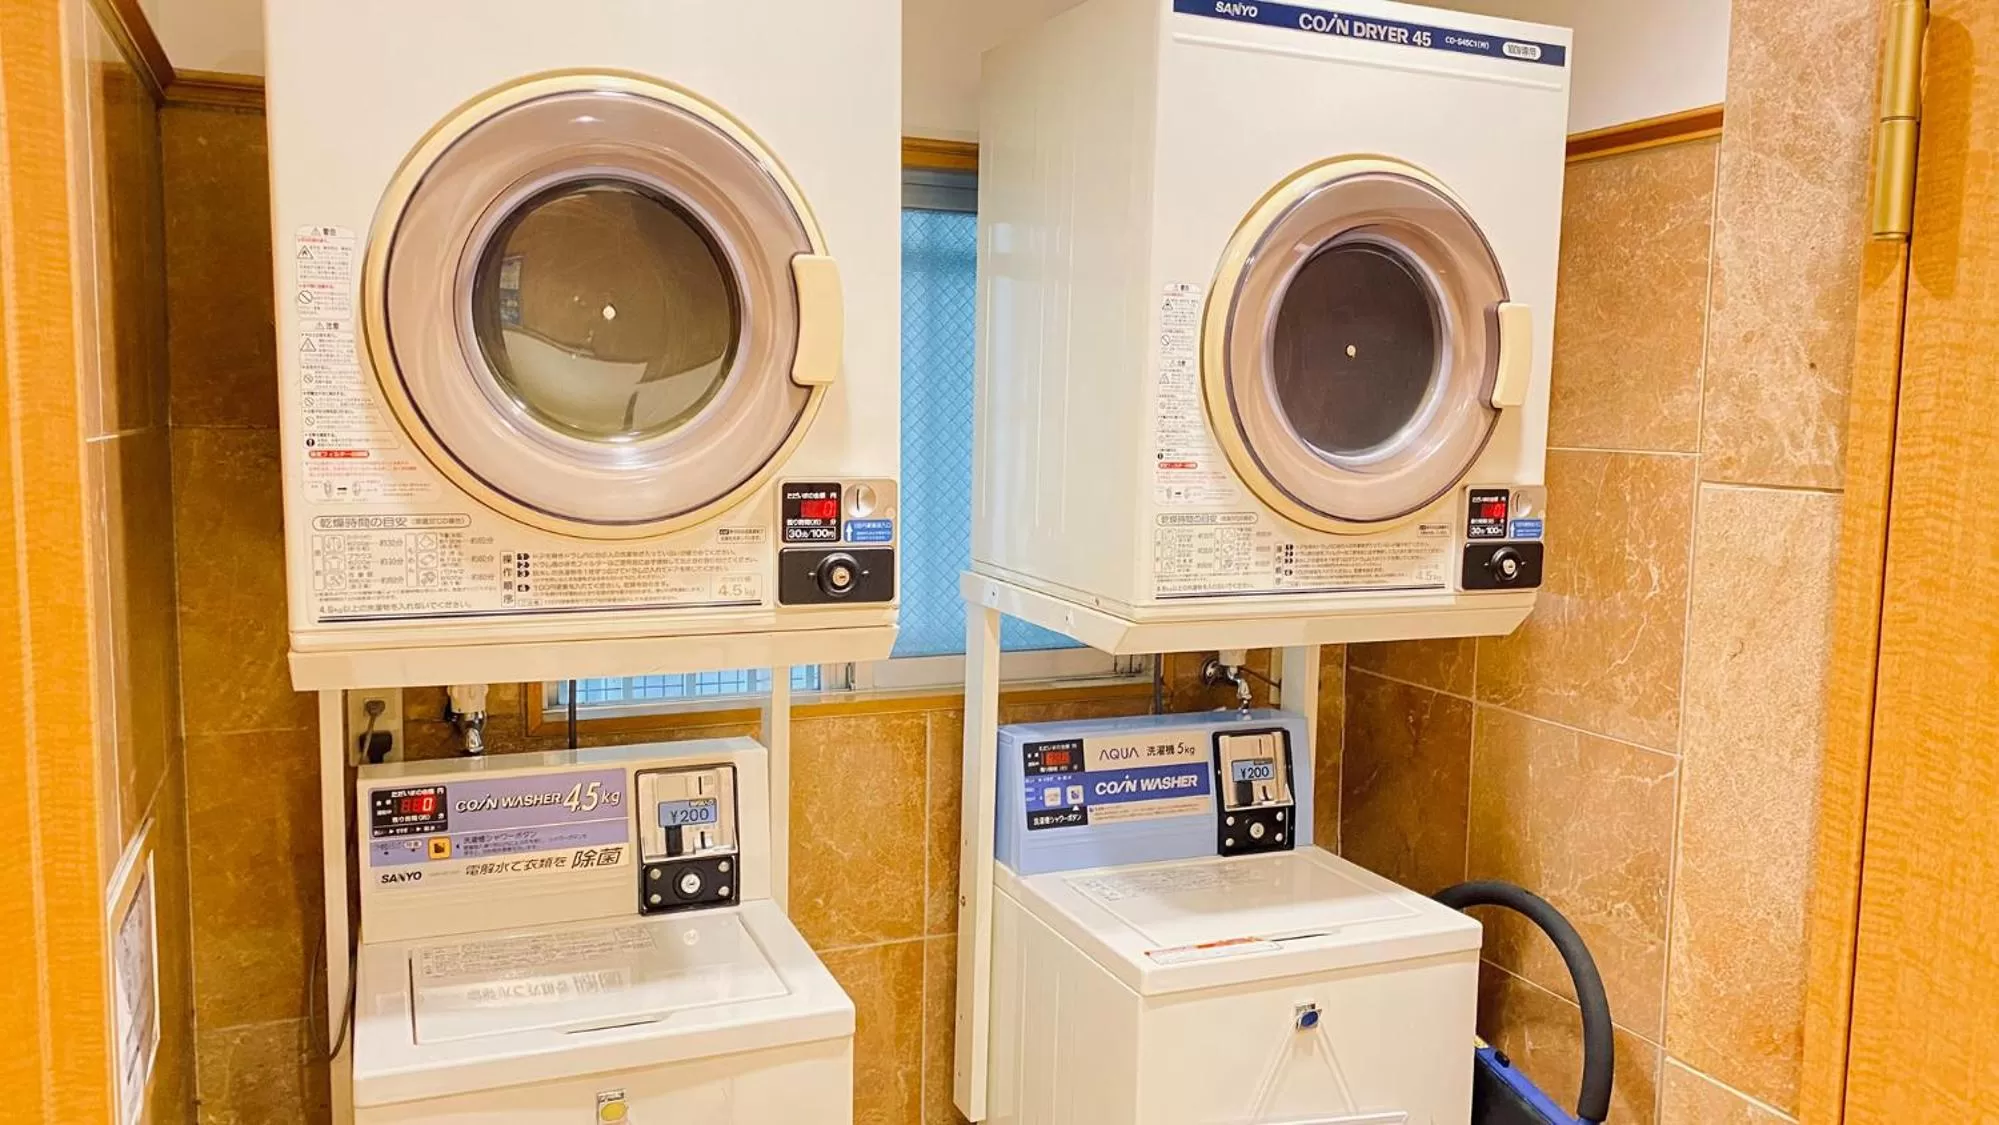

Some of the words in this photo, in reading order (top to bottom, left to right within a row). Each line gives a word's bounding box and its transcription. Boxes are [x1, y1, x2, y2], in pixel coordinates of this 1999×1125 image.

[1215, 1, 1258, 18] SANYO
[1299, 13, 1349, 36] COIN
[1353, 21, 1409, 43] DRYER
[1412, 30, 1432, 47] 45
[1099, 747, 1140, 761] AQUA
[1146, 744, 1175, 757] 洗濯機
[1177, 742, 1195, 756] 5kg
[1095, 774, 1137, 796] COIN
[1140, 775, 1198, 792] WASHER
[456, 793, 499, 813] COIN
[501, 792, 562, 809] WASHER
[671, 808, 709, 824] ¥200
[466, 856, 568, 876] 電解水で衣類を
[572, 847, 624, 869] 除菌
[381, 871, 422, 884] SANYO
